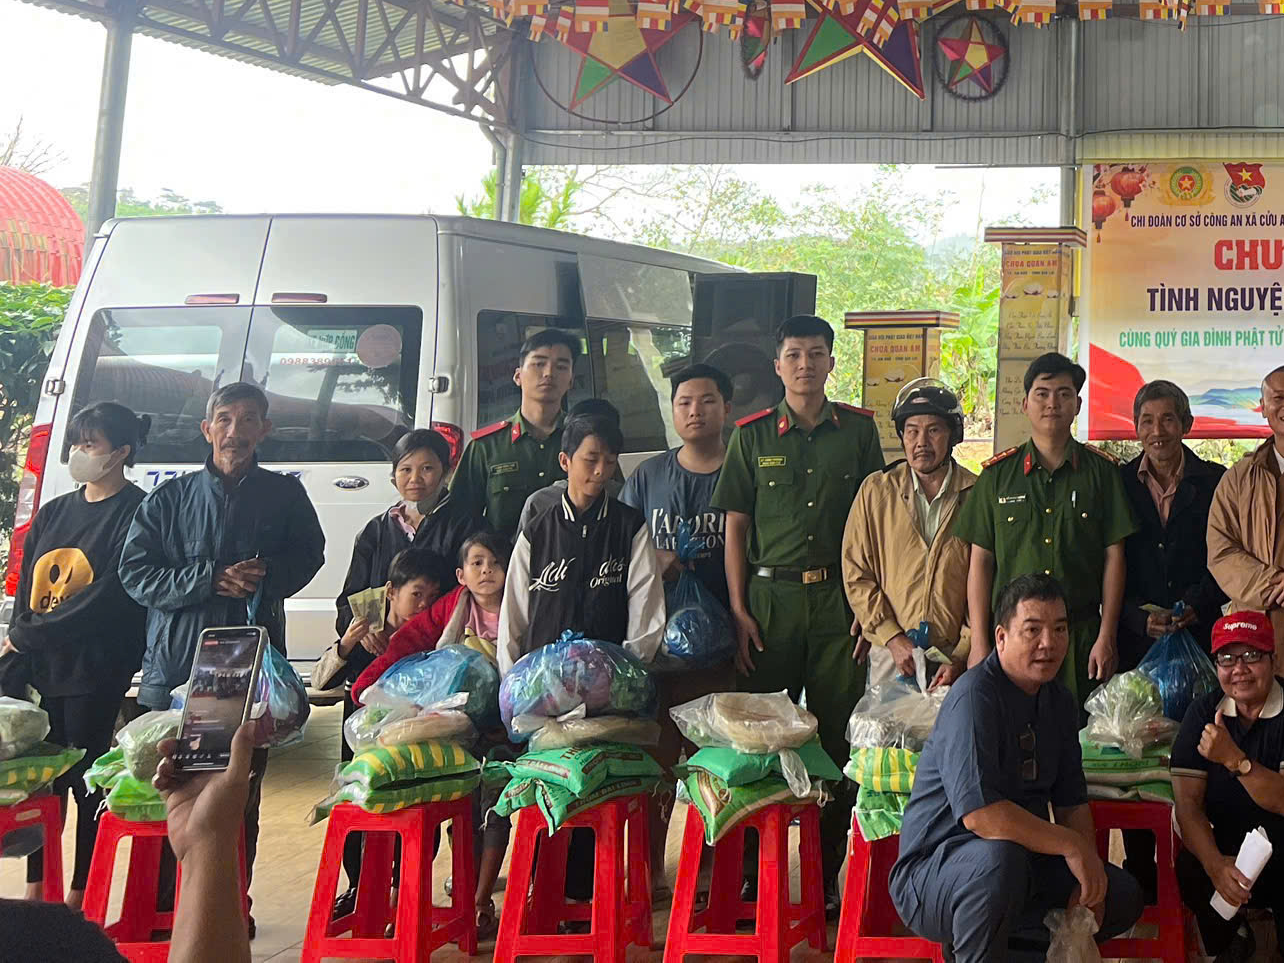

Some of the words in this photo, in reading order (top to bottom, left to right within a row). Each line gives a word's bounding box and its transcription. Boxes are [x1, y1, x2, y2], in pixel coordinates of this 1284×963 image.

[1131, 215, 1145, 227] CHI
[1175, 214, 1187, 227] CƠ
[1190, 211, 1201, 227] SỞ
[1204, 211, 1228, 227] CÔNG
[1230, 214, 1242, 227] AN
[1245, 212, 1257, 227] XÃ
[1147, 282, 1199, 312] TÌNH
[1119, 328, 1150, 347] CÙNG
[1155, 328, 1177, 348] QUÝ
[1181, 331, 1199, 347] GIA
[1203, 327, 1231, 347] ĐÌNH
[1235, 327, 1265, 349] PHẬT
[1268, 325, 1283, 346] TỬ
